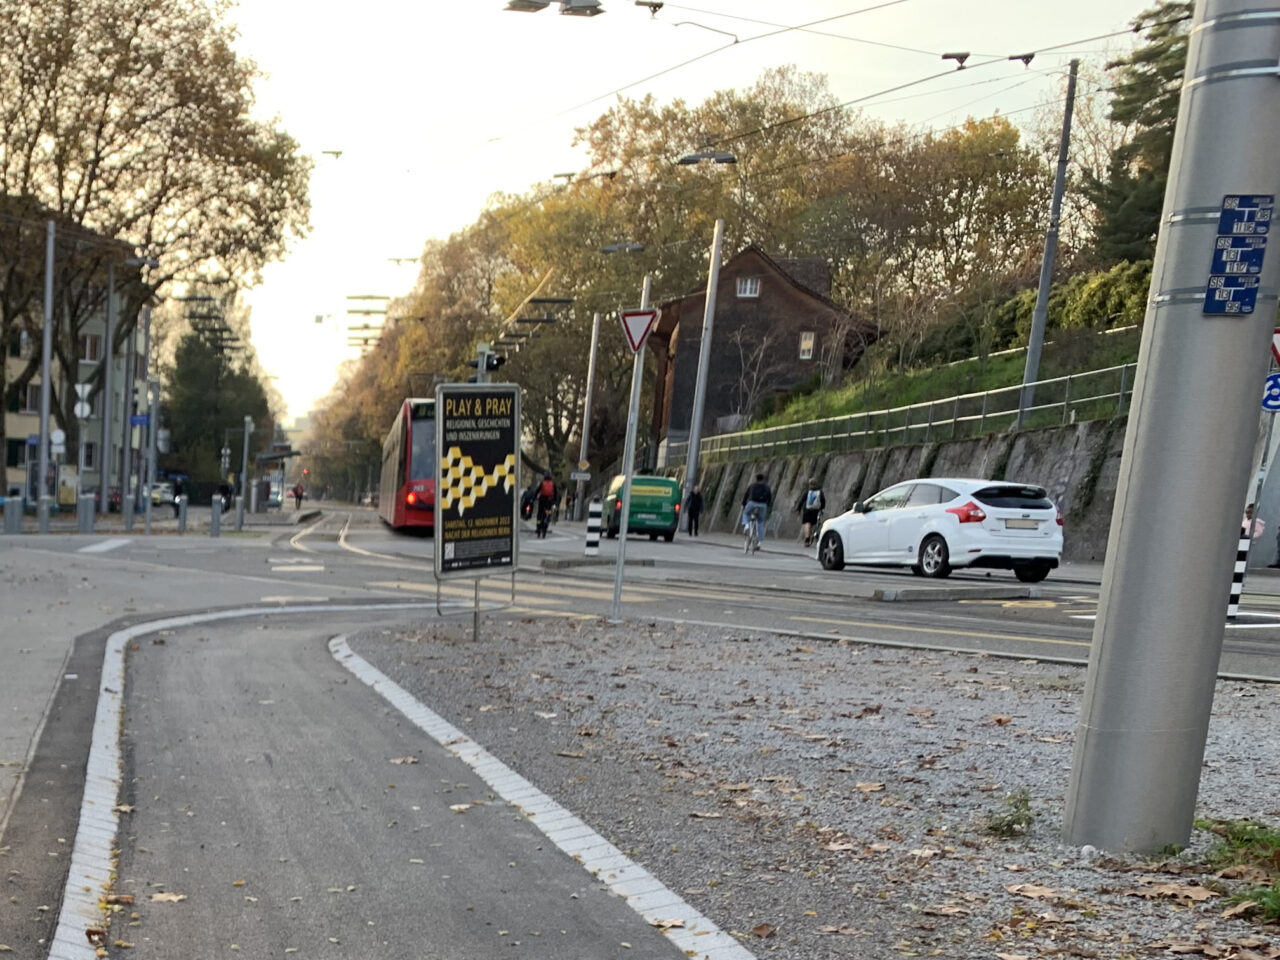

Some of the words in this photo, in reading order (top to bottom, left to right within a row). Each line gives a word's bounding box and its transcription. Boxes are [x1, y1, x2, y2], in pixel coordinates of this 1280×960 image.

[446, 398, 472, 417] PLAY
[474, 398, 482, 416] &
[485, 397, 512, 416] PRAY
[477, 417, 511, 430] GESCHICHTEN
